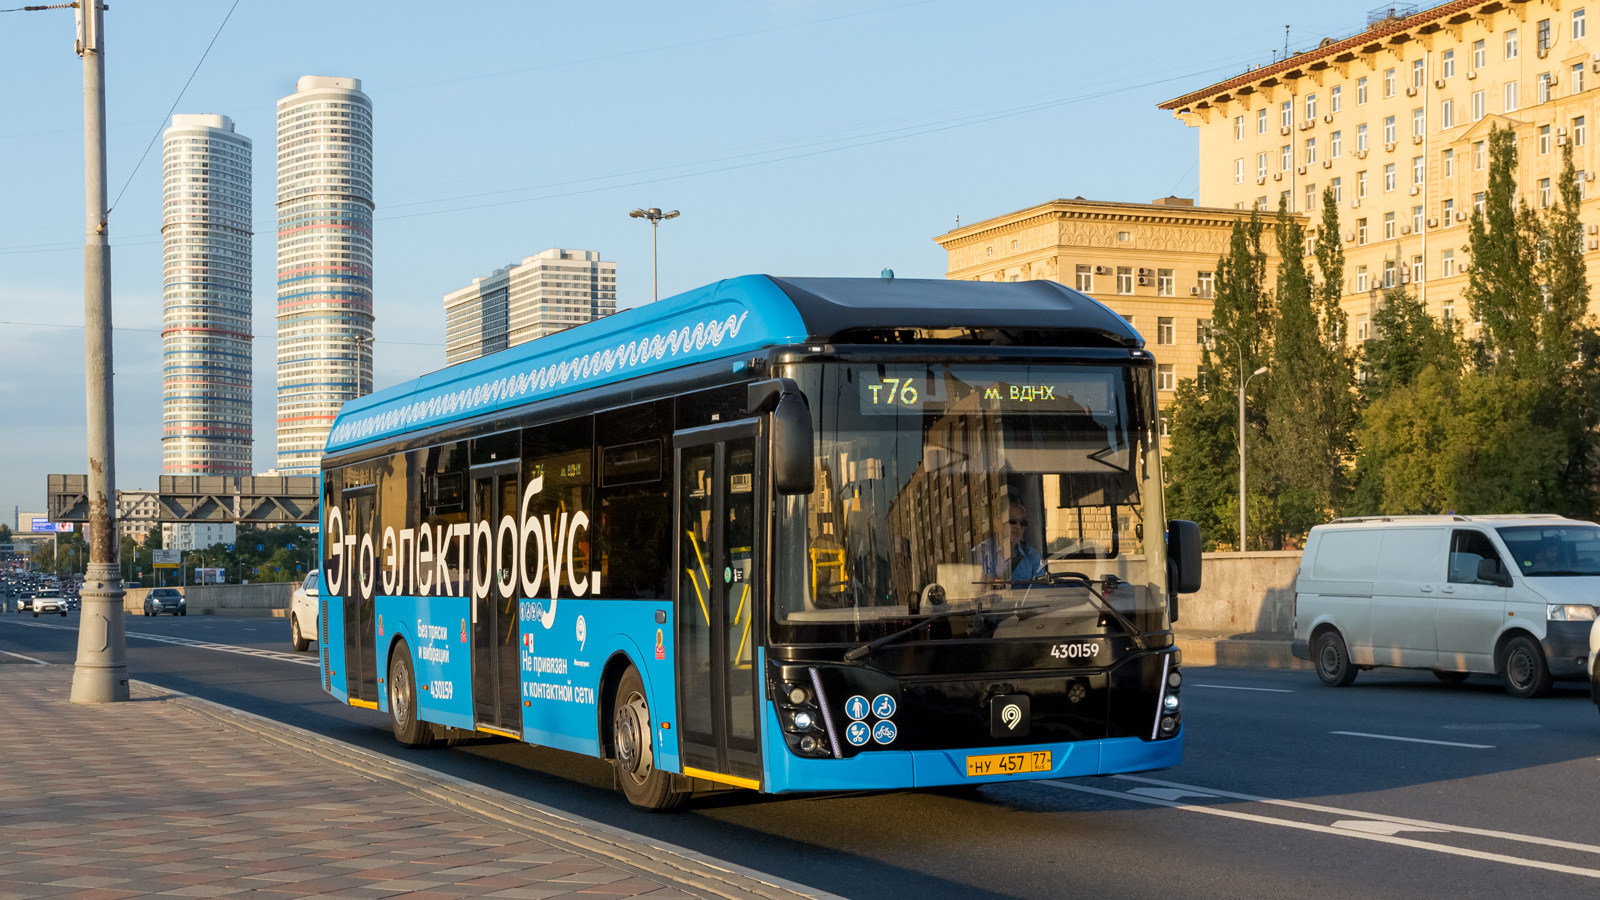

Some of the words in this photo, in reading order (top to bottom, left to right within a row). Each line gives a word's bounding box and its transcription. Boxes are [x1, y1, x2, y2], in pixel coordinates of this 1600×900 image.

[868, 378, 918, 404] т76
[1010, 385, 1055, 402] ВДНХ
[327, 505, 374, 600] Это
[382, 474, 601, 629] электробус.
[417, 619, 428, 638] Без
[428, 624, 448, 643] тряски
[418, 646, 423, 659] и
[423, 642, 450, 665] вибраций
[1050, 643, 1100, 659] 430159
[522, 650, 533, 672] Не
[533, 656, 568, 677] привязан
[430, 681, 453, 700] 430159
[523, 681, 528, 697] к
[529, 679, 573, 702] контактной
[574, 686, 595, 705] сети
[998, 755, 1025, 772] 457
[1032, 753, 1047, 765] 77
